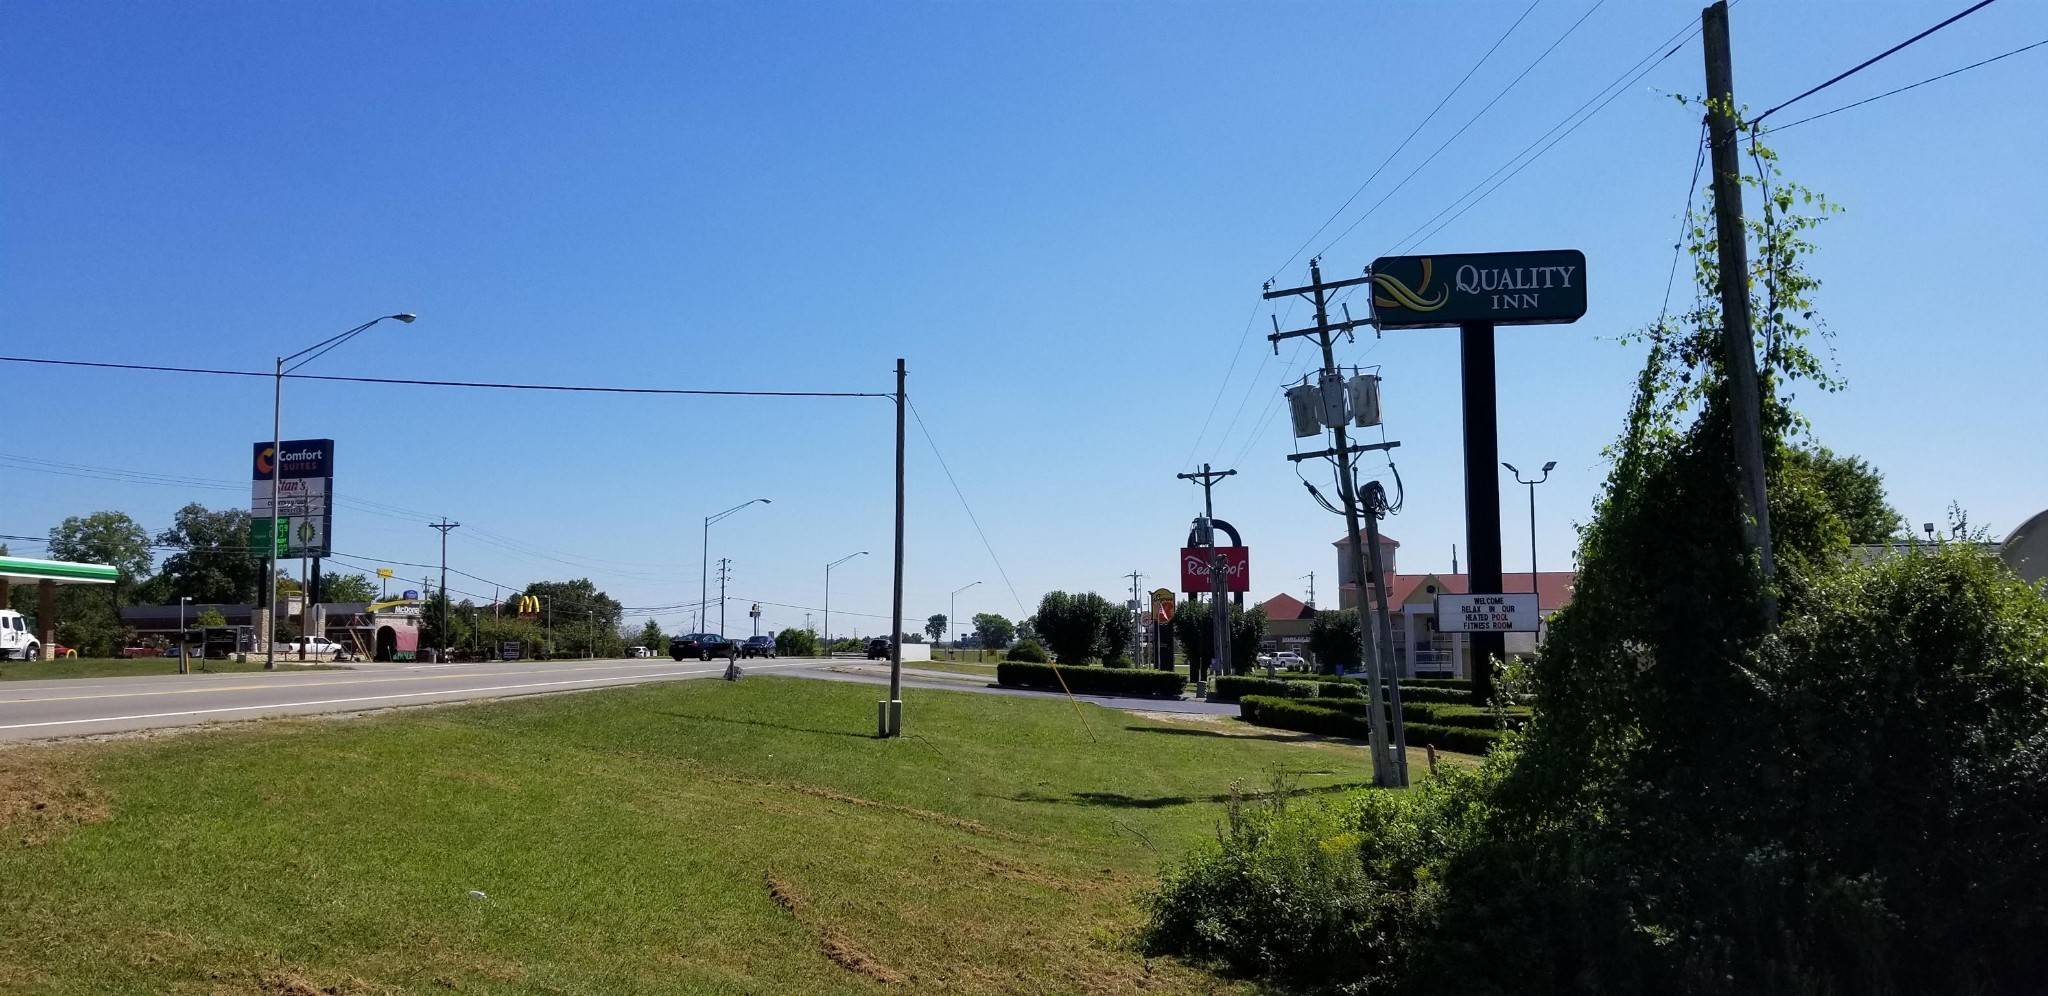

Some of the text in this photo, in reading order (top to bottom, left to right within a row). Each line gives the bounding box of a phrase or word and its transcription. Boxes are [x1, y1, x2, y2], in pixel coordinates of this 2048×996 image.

[1456, 264, 1575, 294] QUALITY
[1491, 294, 1539, 309] INN
[279, 448, 322, 462] Comfort
[283, 462, 317, 471] SUITES
[1474, 597, 1504, 605] WELCOME
[1461, 605, 1515, 614] RELAX IN OUR
[1465, 613, 1508, 621] HEATED POOL
[1463, 621, 1512, 630] FITNESS ROOM
